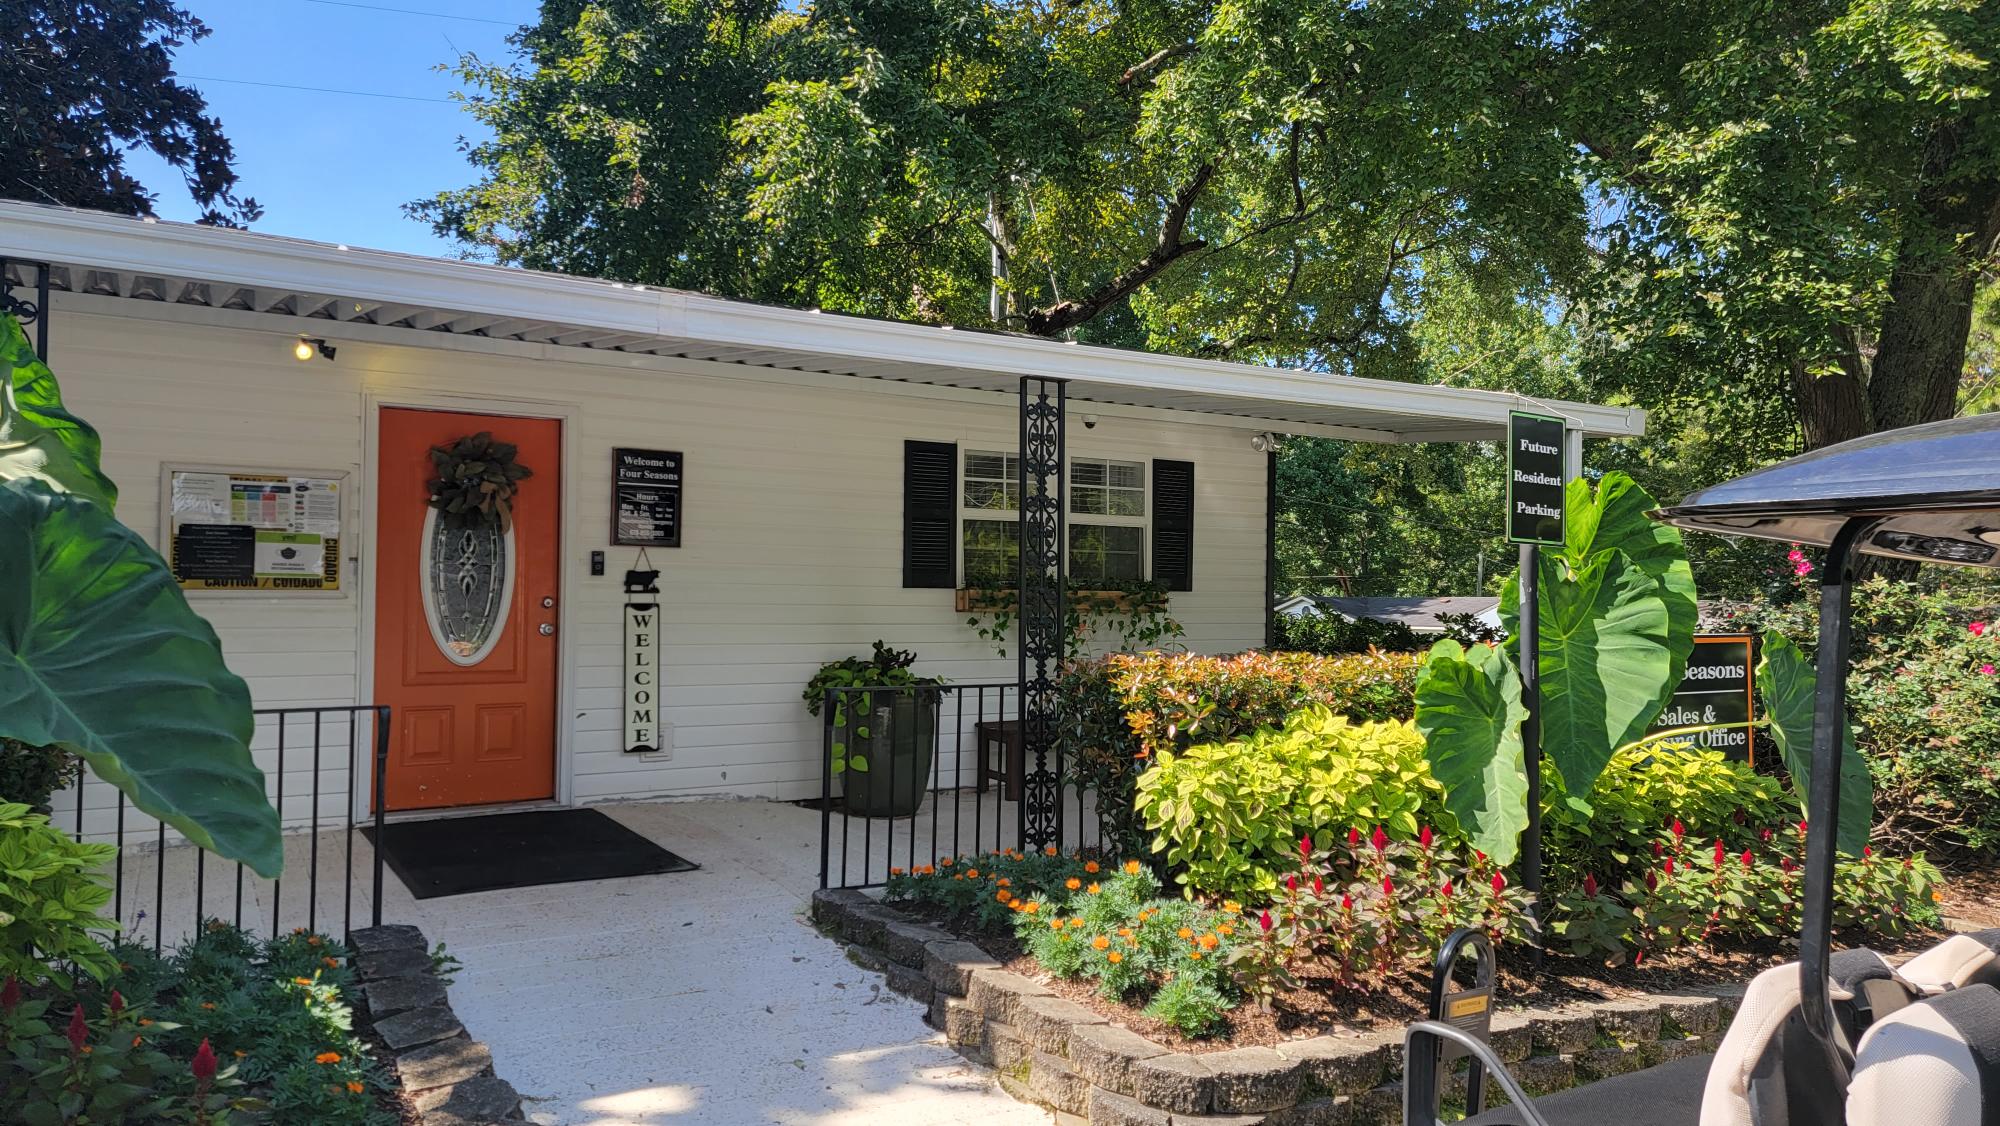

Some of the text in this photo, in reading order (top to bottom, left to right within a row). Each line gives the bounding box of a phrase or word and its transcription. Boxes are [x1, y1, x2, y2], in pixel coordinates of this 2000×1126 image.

[1520, 438, 1558, 455] Future
[623, 456, 675, 468] Welcome to
[620, 468, 679, 481] Four Seasons
[1513, 469, 1561, 486] Resident
[636, 493, 659, 501] Hours
[1516, 501, 1561, 520] Parking
[324, 537, 338, 583] CUIDADO
[273, 577, 323, 588] CUIDADO
[632, 614, 653, 743] WELCOME
[1657, 704, 1717, 726] Sales &
[1699, 728, 1746, 748] Office
